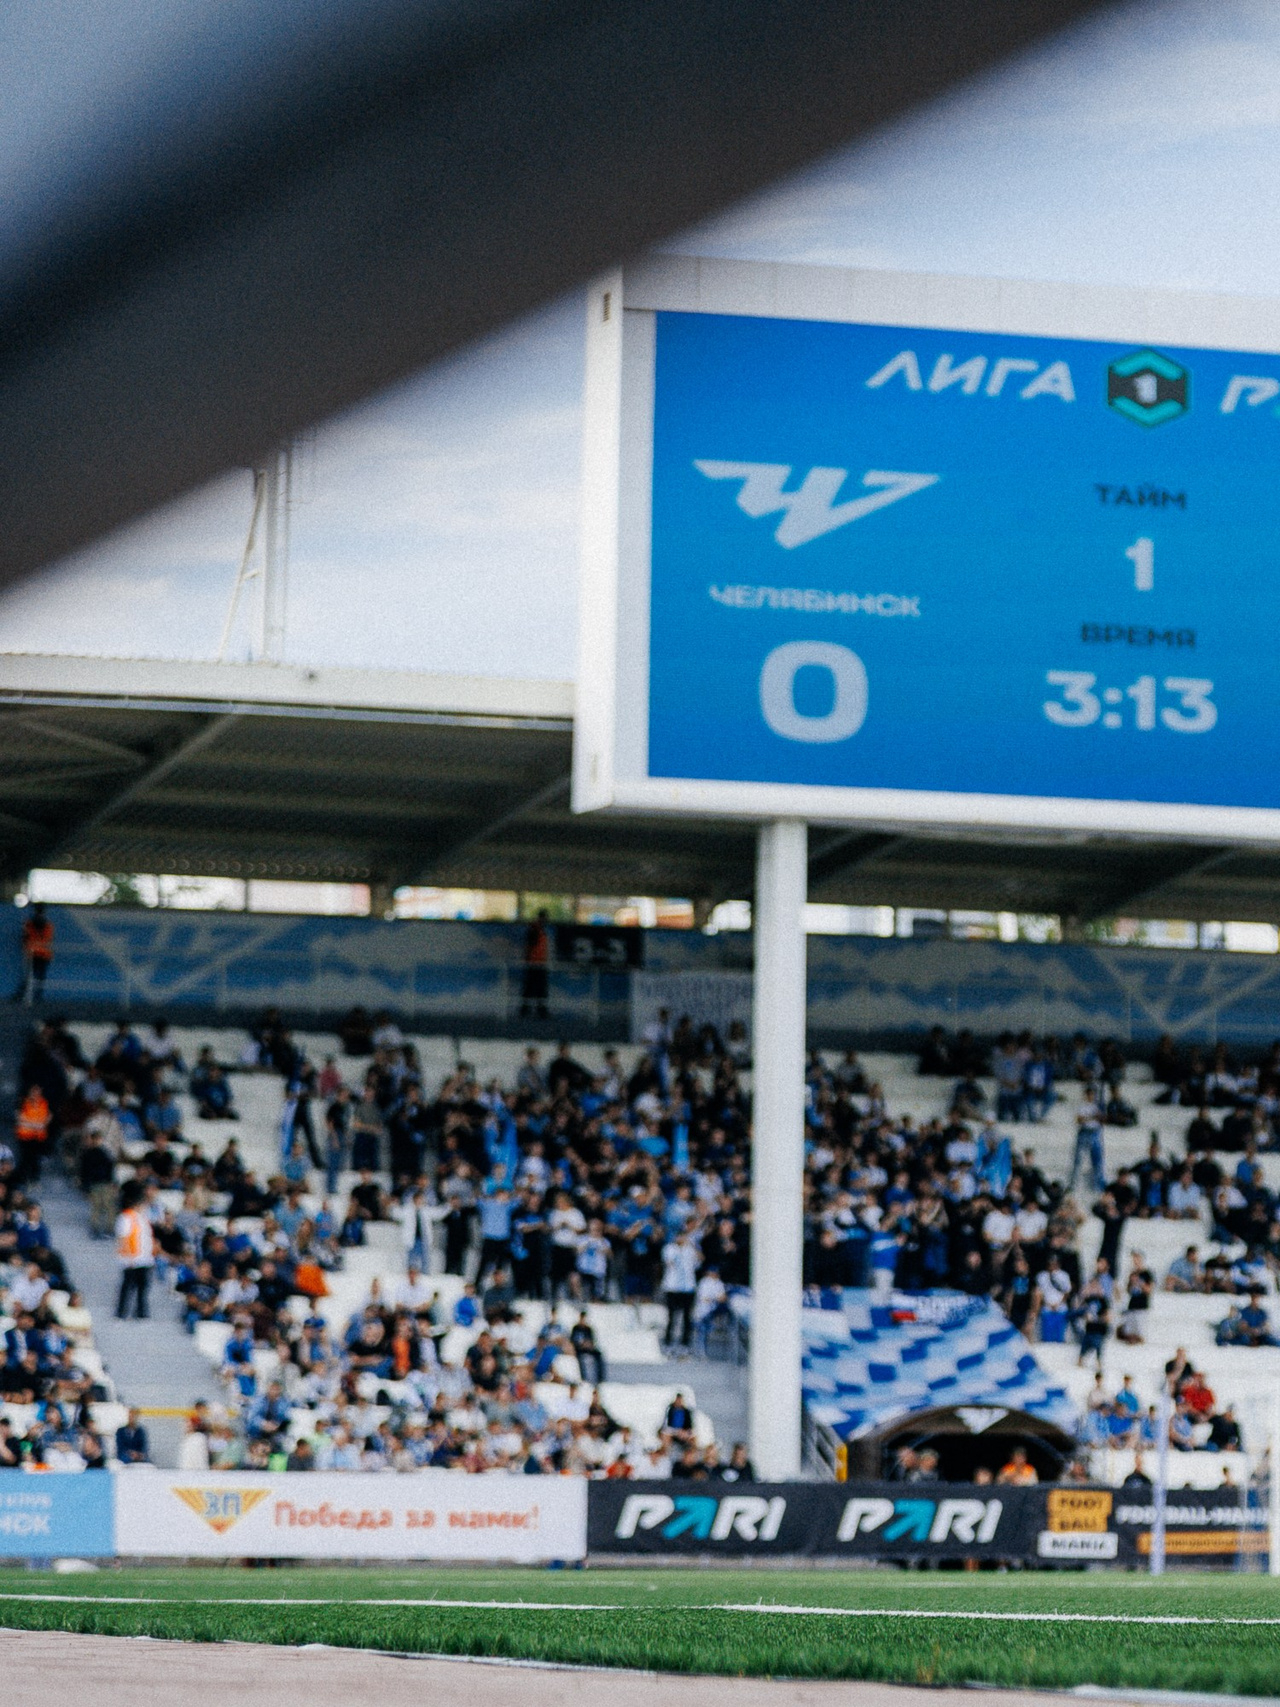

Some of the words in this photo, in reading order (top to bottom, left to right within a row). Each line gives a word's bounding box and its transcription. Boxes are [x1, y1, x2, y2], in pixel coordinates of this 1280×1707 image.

[865, 350, 1076, 402] ЛИГА
[1094, 483, 1187, 510] ТАЙМ
[1125, 537, 1154, 591] 1
[709, 584, 921, 617] ЧЕЛЯБИНСК
[1080, 622, 1196, 649] ВРЕМЯ
[759, 640, 869, 743] 0
[1043, 670, 1218, 733] 3:13
[274, 1500, 394, 1530] Победа
[404, 1509, 436, 1529] за
[448, 1504, 539, 1530] нами!
[614, 1494, 787, 1542] PARI
[836, 1497, 1003, 1543] PARI
